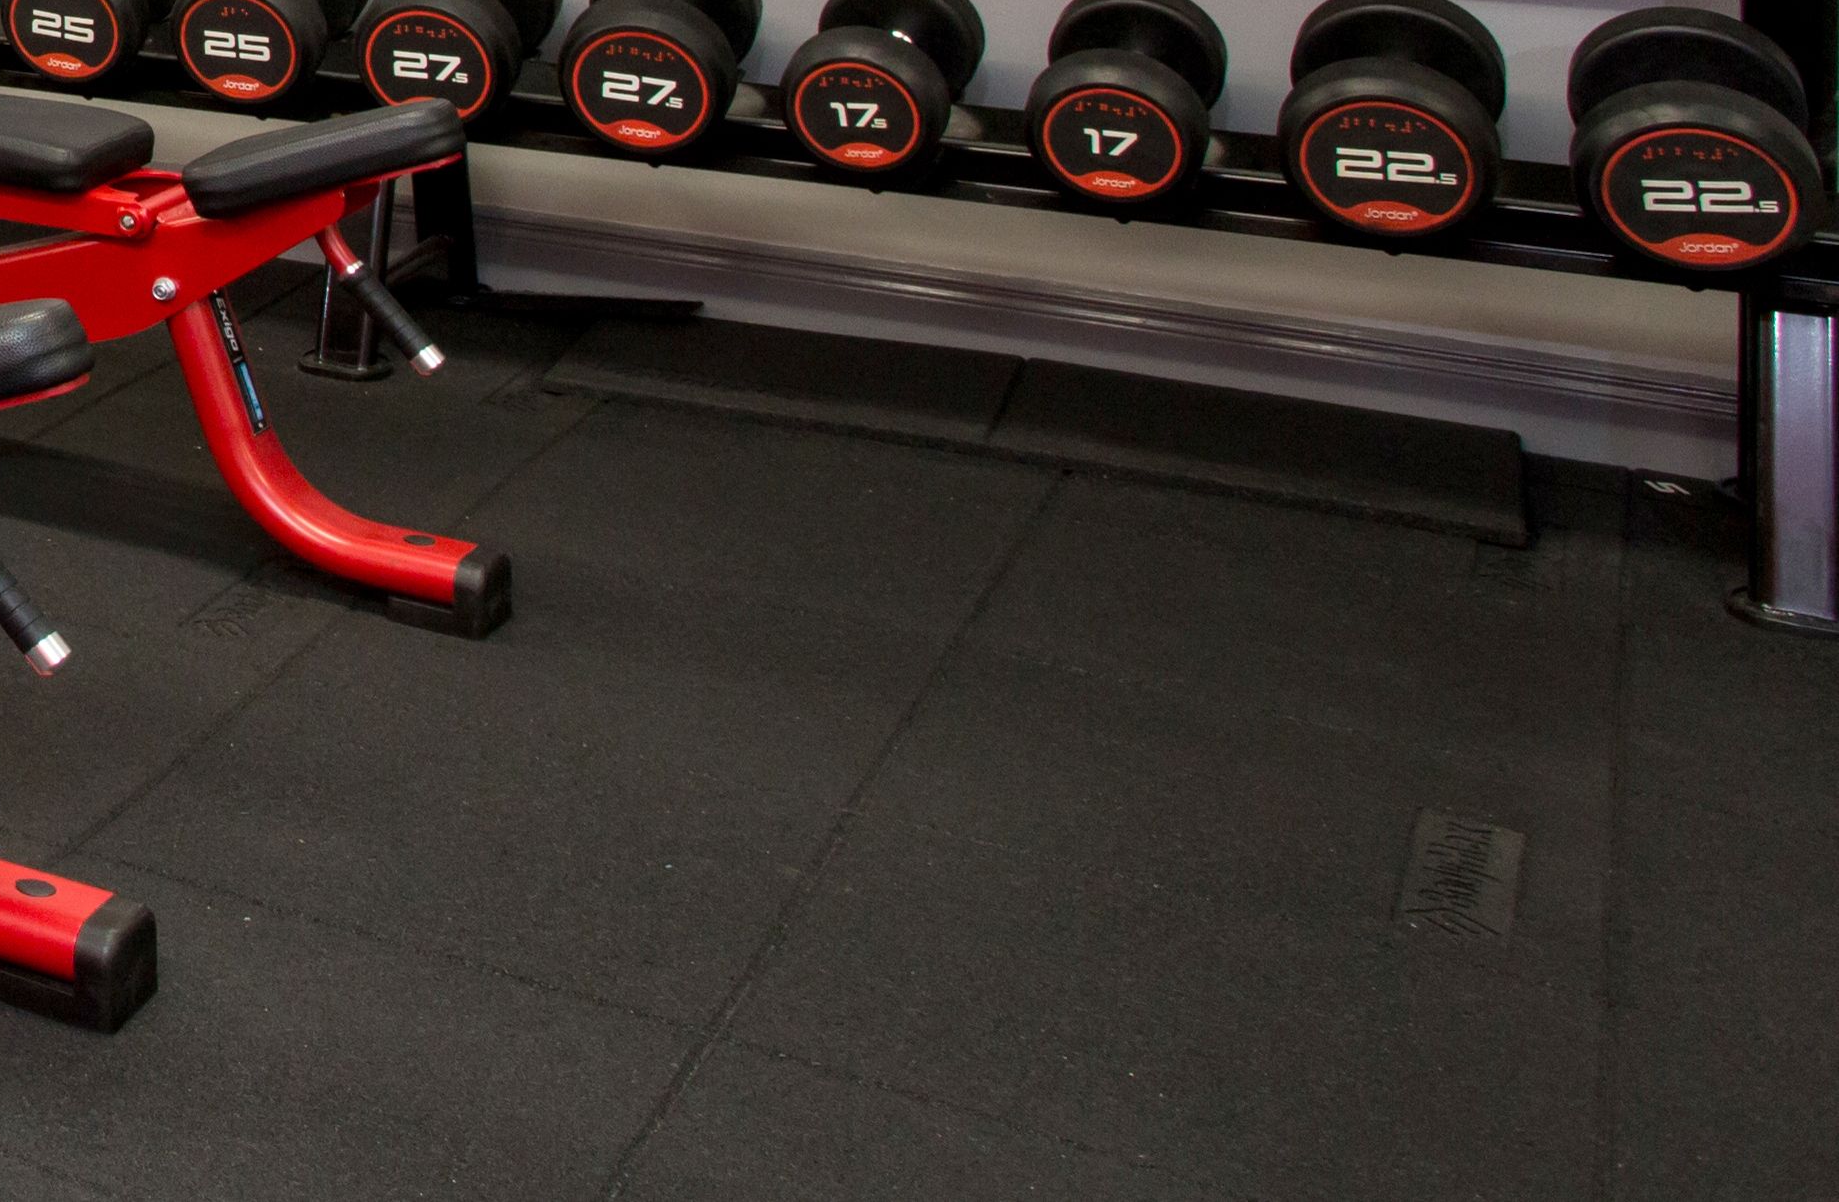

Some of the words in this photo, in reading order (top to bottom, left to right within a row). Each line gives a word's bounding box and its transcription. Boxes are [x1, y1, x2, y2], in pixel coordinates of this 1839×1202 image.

[31, 8, 95, 44] 25
[203, 29, 271, 63] 25
[391, 49, 469, 85] 27.5
[600, 70, 685, 110] 27.5
[829, 100, 889, 130] 17.5
[1083, 126, 1140, 158] 17
[1335, 146, 1458, 187] 22.5
[1641, 178, 1780, 215] 22.5
[216, 298, 239, 352] Exigo
